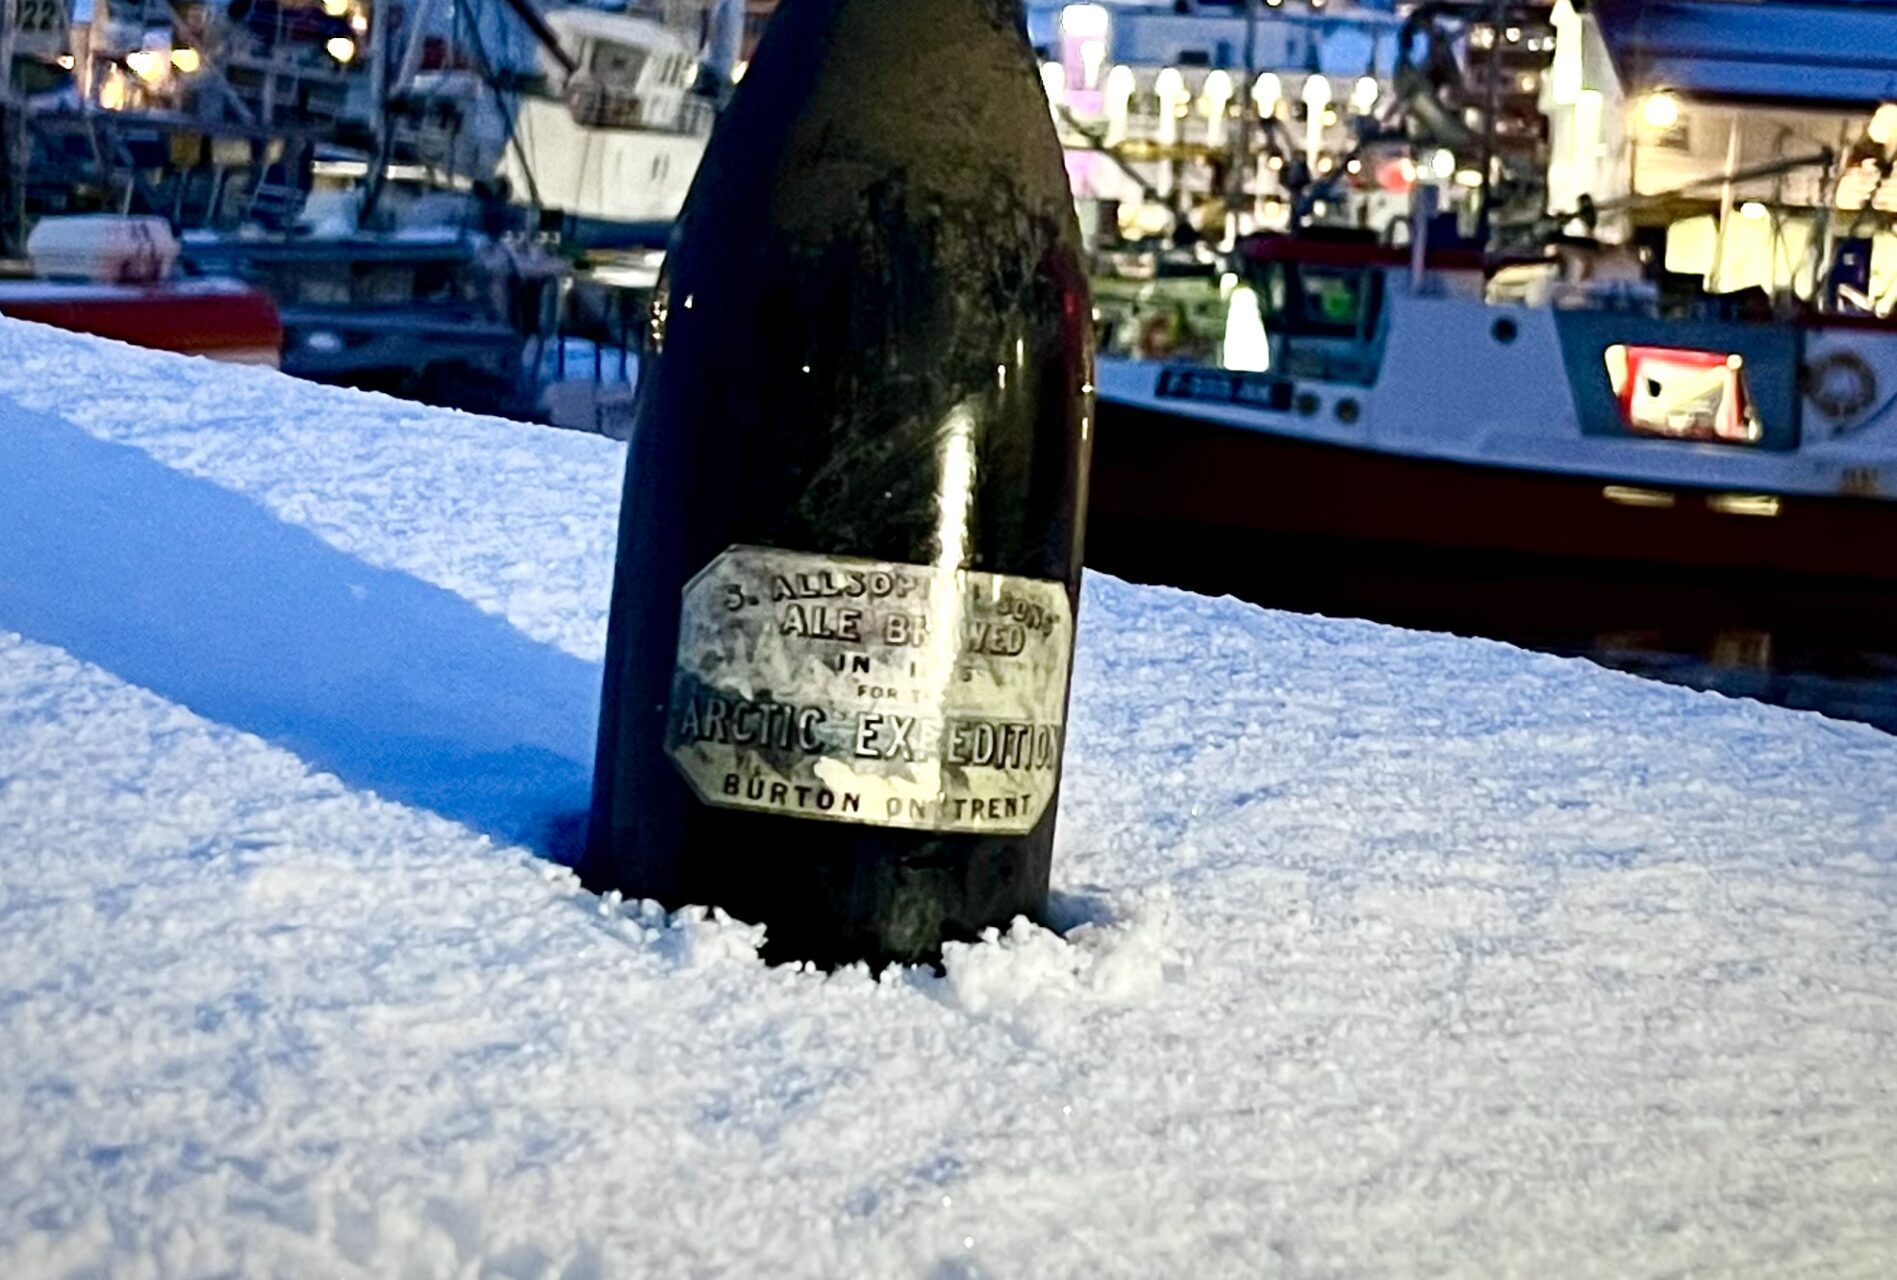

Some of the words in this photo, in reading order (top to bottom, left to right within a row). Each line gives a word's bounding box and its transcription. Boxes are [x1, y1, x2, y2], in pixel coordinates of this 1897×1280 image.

[780, 603, 862, 642] ALE
[838, 653, 870, 674] IN
[857, 685, 898, 700] FOR
[678, 696, 827, 755] ARCTIC
[723, 773, 861, 814] BURTON
[886, 796, 925, 819] ON
[952, 793, 1031, 820] TRENT
